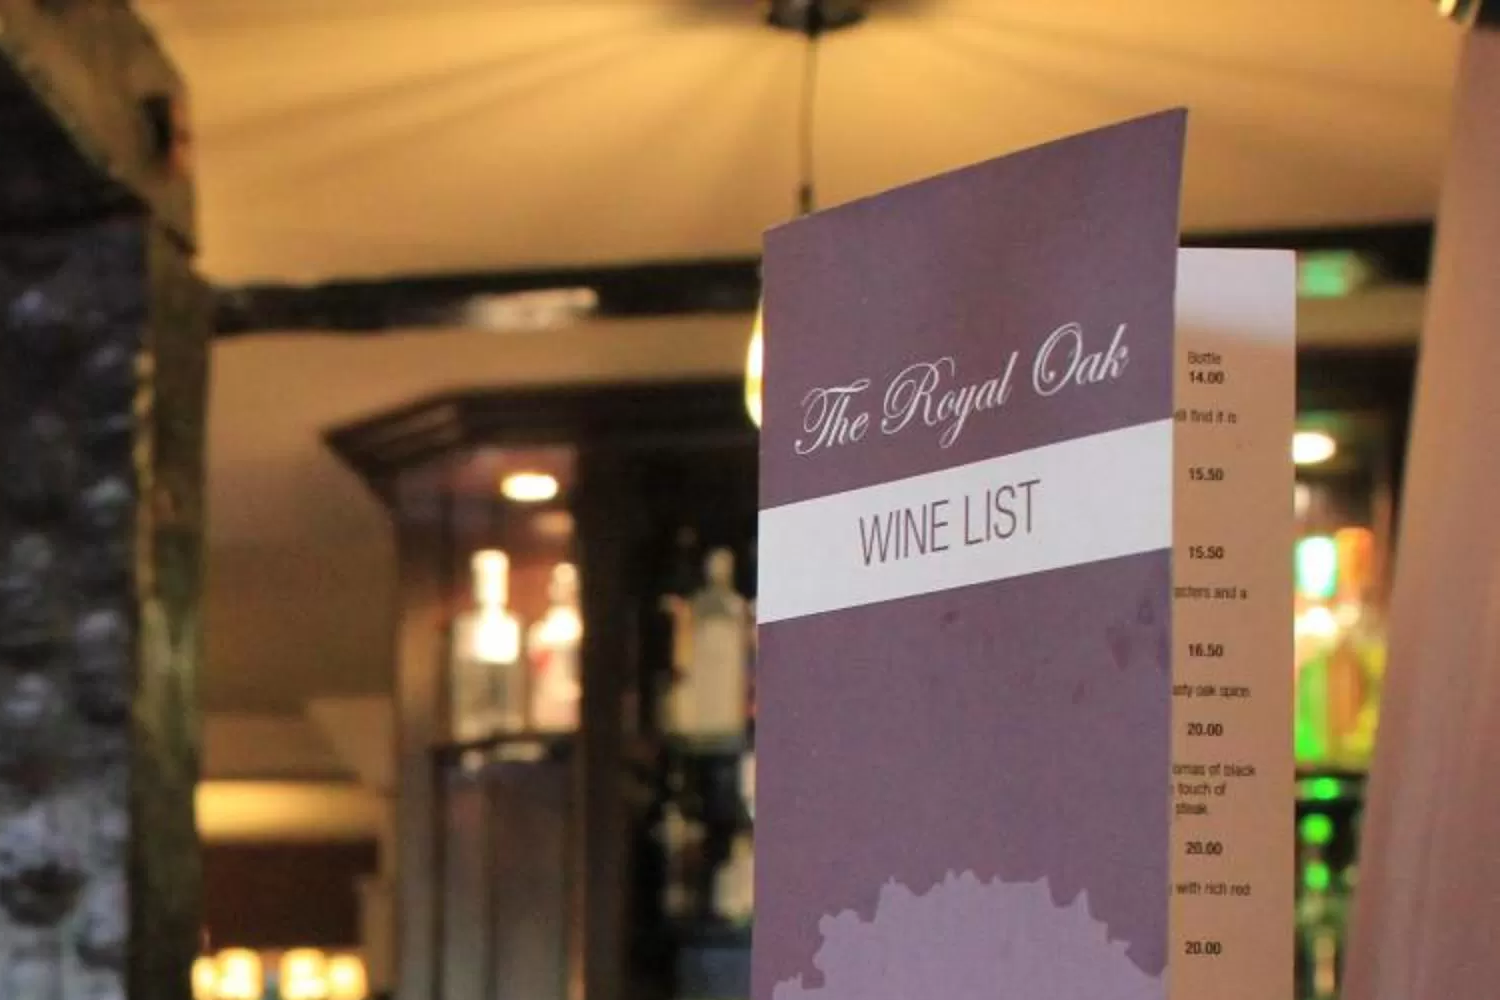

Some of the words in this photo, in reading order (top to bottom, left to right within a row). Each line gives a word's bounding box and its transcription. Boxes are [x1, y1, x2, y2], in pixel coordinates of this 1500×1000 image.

[1187, 351, 1221, 364] Bottle
[1189, 370, 1224, 384] 14.00
[795, 378, 870, 455] The
[881, 351, 1019, 448] Royal
[1032, 322, 1130, 397] Oak
[1188, 467, 1224, 480] 15.50
[858, 500, 950, 566] WINE
[964, 478, 1042, 546] LIST
[1188, 546, 1224, 559] 15.50
[1188, 643, 1224, 657] 16.50
[1187, 722, 1224, 736] 20.00
[1185, 841, 1223, 855] 20.00
[1184, 940, 1222, 955] 20.00
